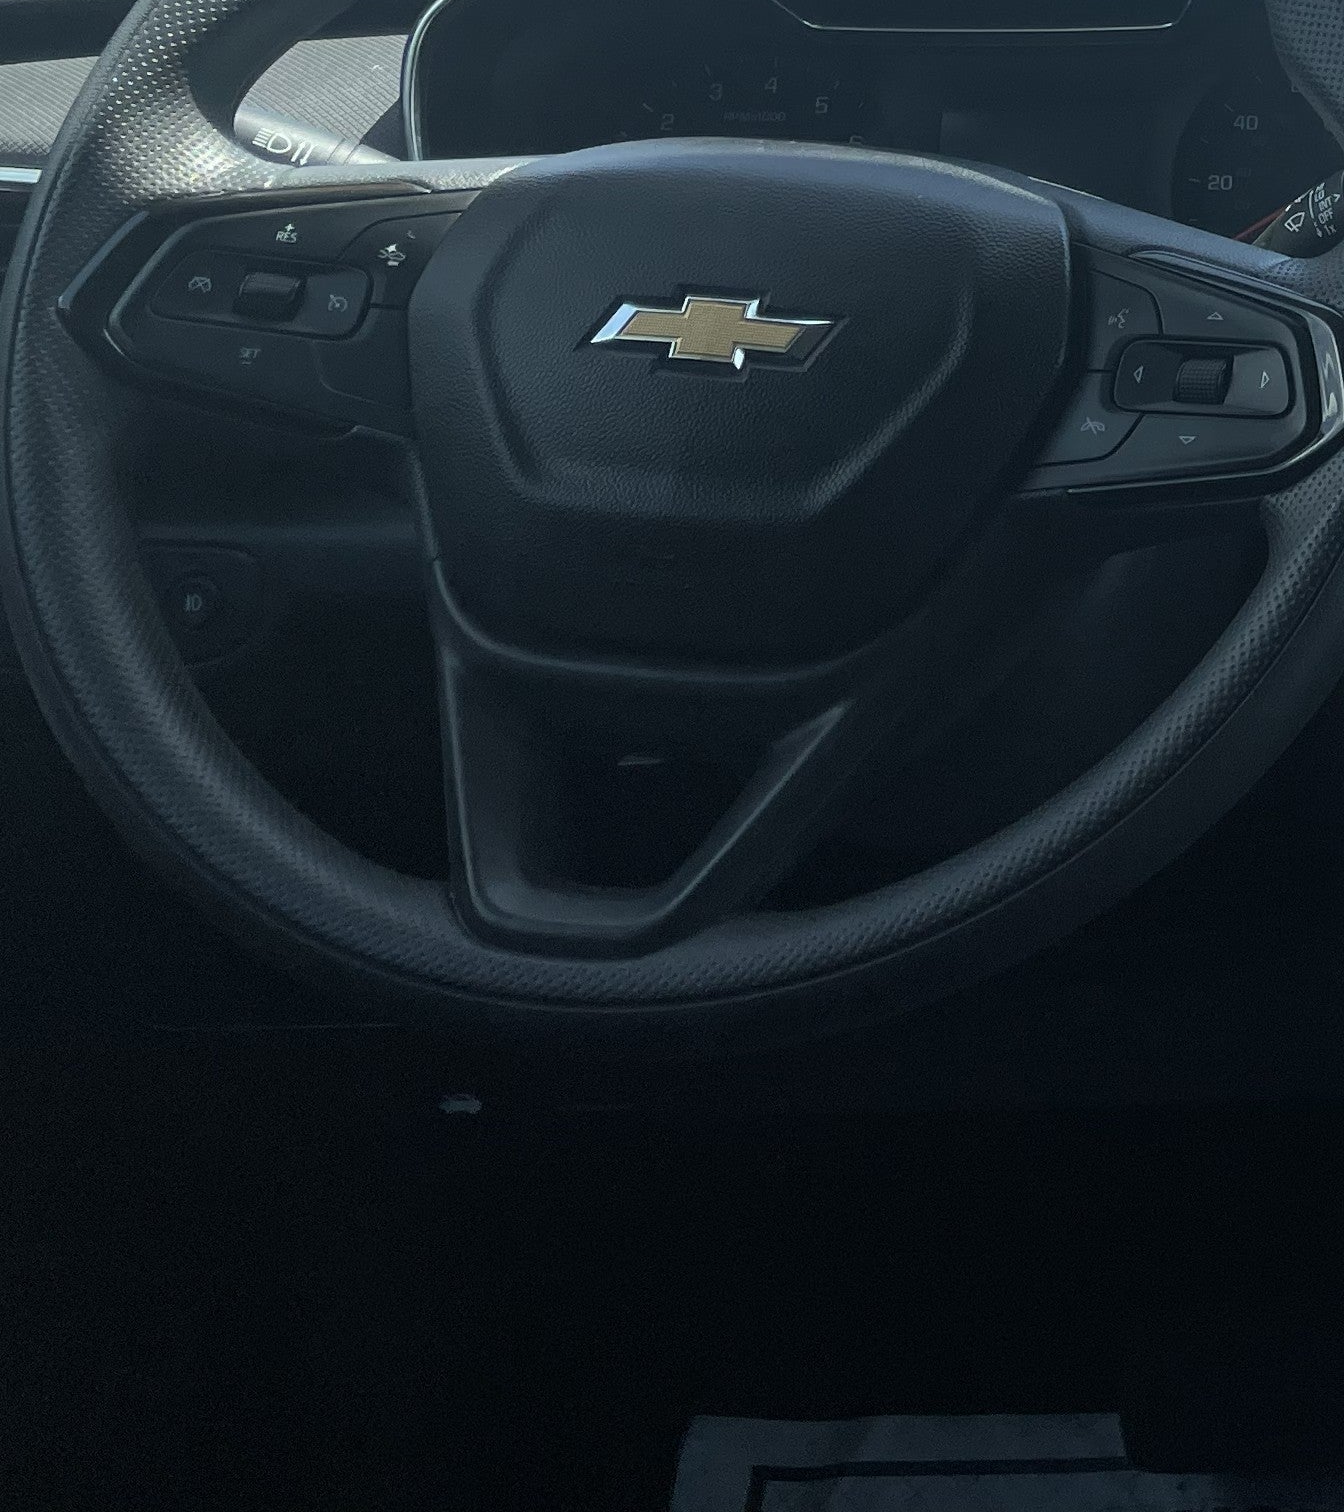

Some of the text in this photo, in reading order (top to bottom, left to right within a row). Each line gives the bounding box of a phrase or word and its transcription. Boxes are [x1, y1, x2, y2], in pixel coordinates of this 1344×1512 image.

[1233, 115, 1259, 131] 40
[1207, 175, 1233, 191] 20
[1314, 190, 1325, 202] LO
[1318, 196, 1331, 211] INT
[1318, 207, 1334, 224] OFF
[276, 231, 298, 244] RES
